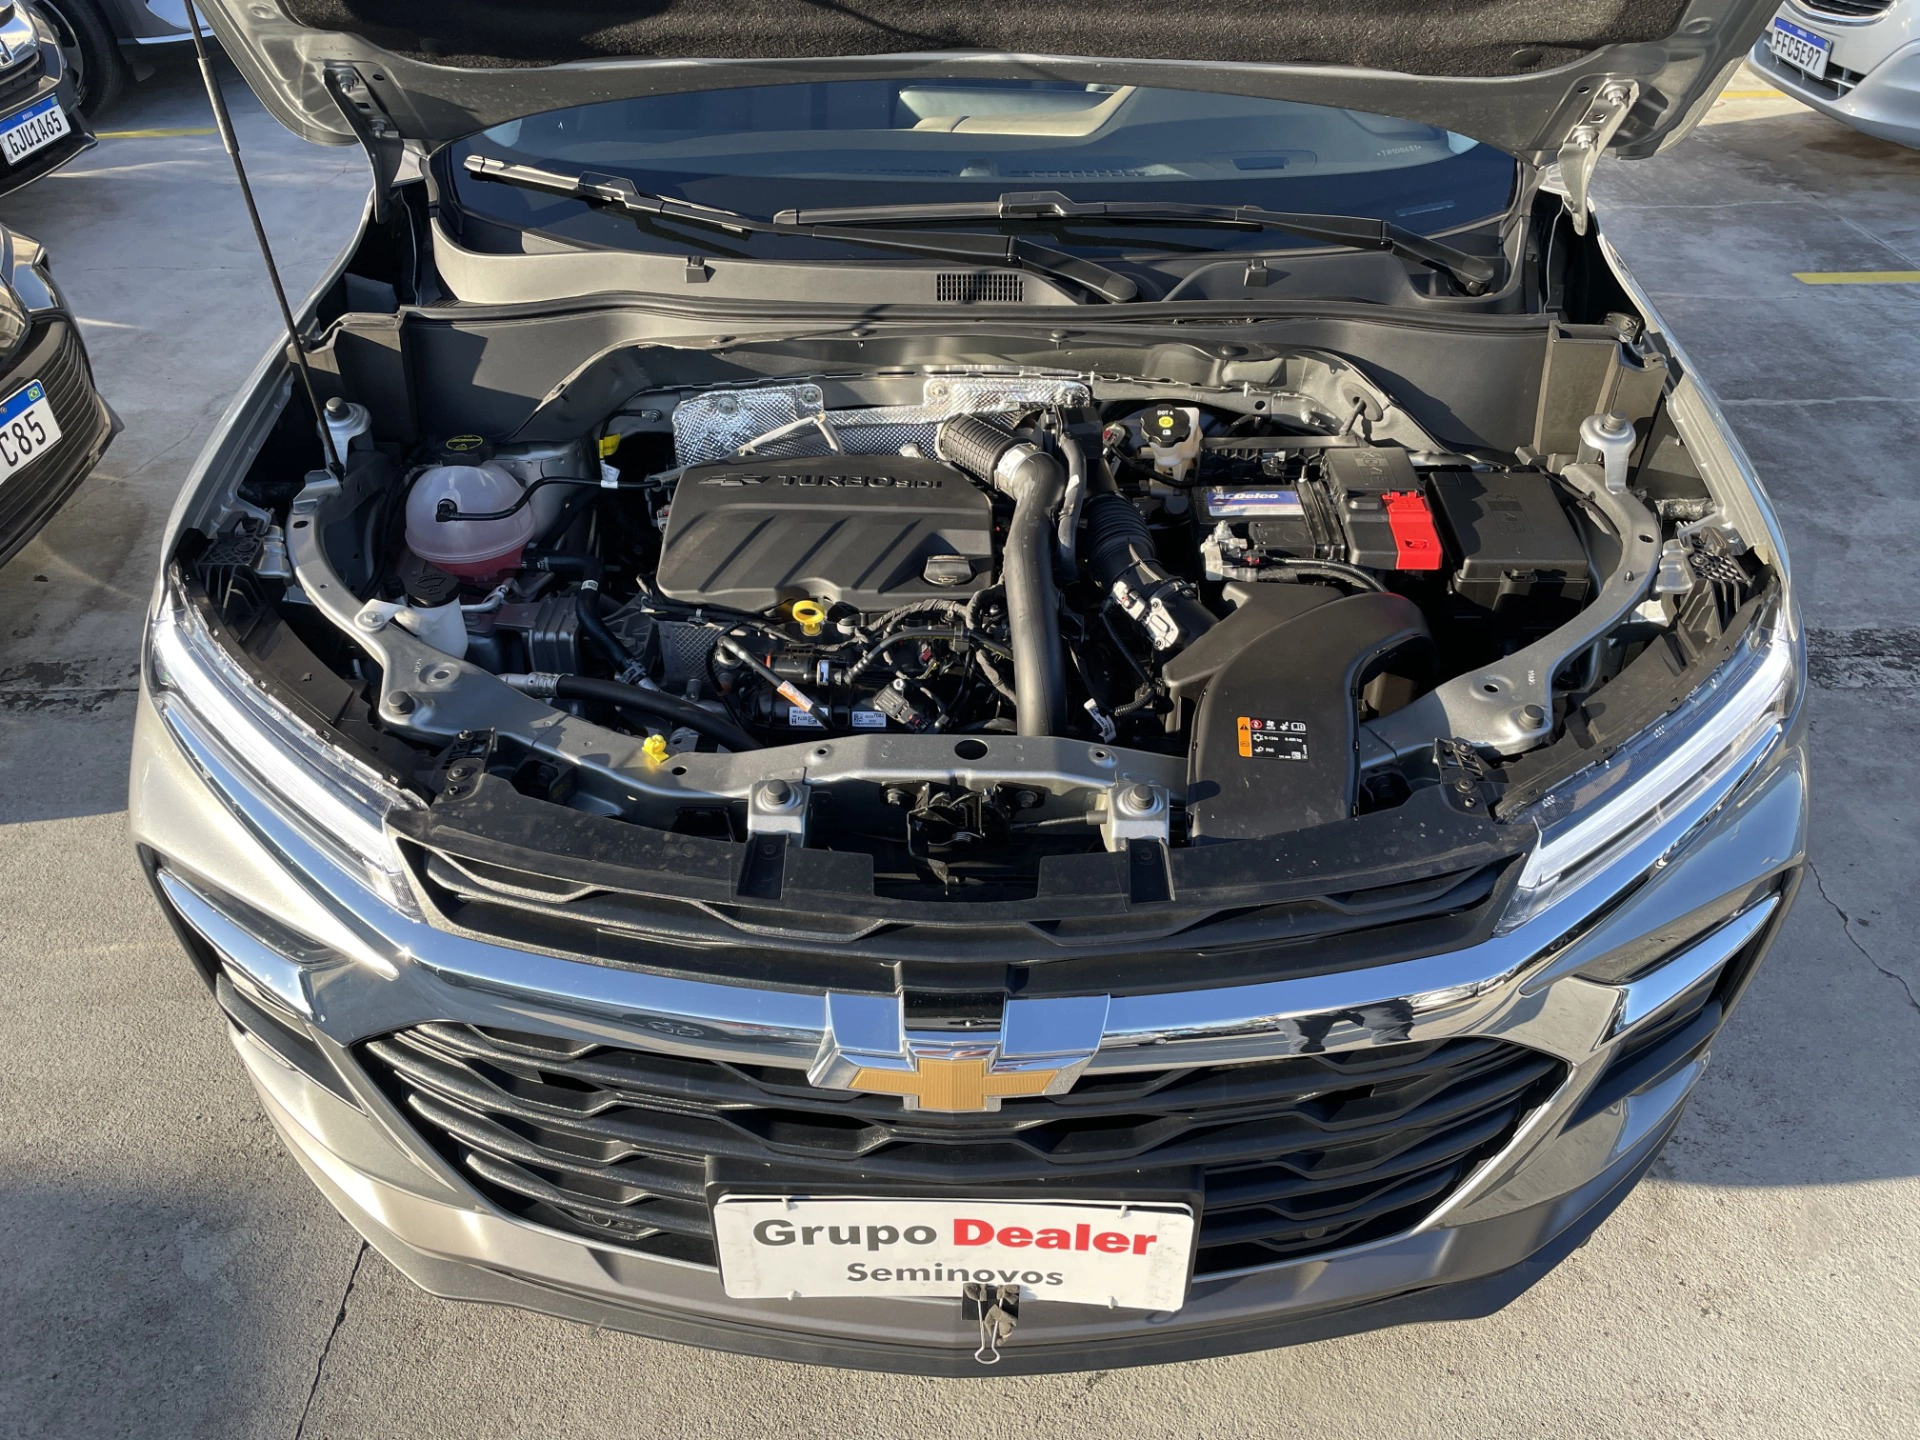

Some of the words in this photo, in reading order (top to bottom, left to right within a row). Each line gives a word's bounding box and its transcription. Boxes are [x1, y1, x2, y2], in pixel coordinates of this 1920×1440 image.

[1774, 31, 1821, 71] FFC5E97
[7, 110, 63, 156] GJU1A65
[753, 1218, 937, 1251] Grupo
[953, 1218, 1157, 1255] Dealer
[846, 1262, 1064, 1286] Seminovos
